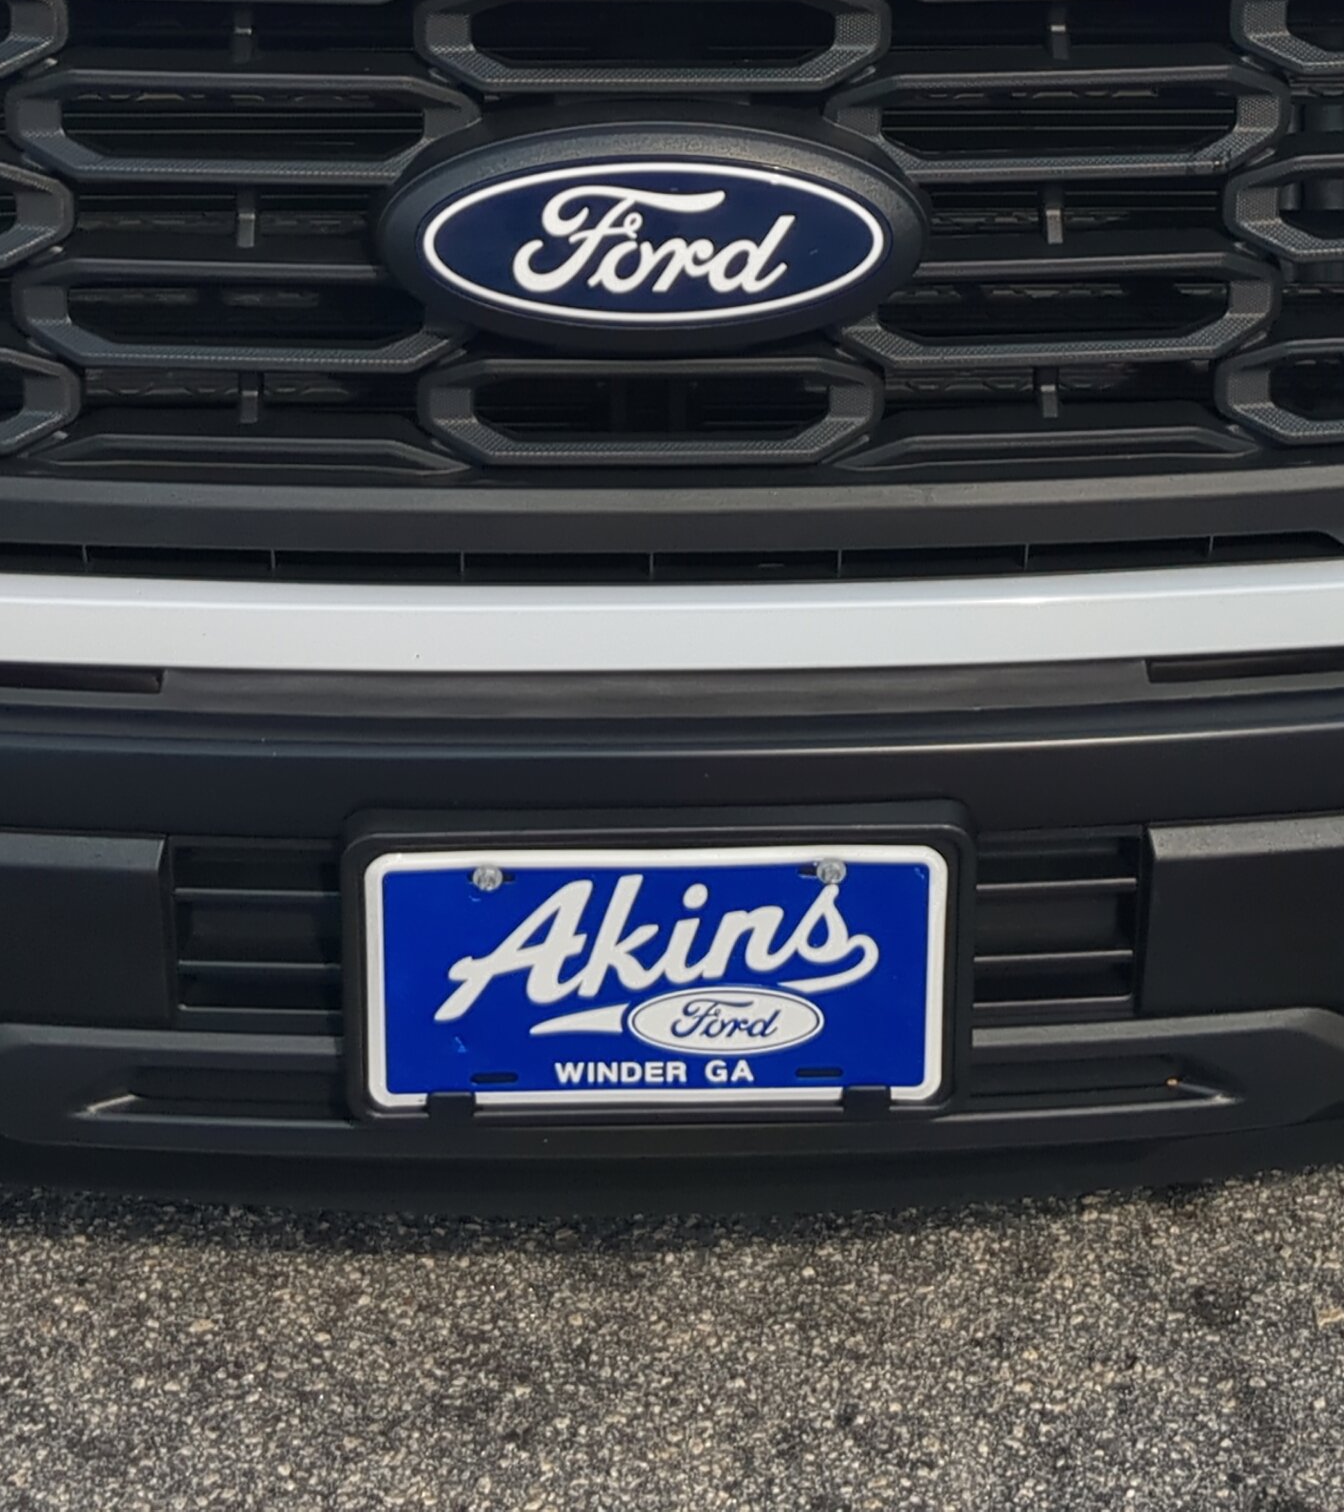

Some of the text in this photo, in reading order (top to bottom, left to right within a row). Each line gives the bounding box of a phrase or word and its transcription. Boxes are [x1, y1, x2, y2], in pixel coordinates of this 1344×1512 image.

[512, 185, 796, 294] Ford
[433, 873, 880, 1022] Akins
[670, 1000, 780, 1038] Ford
[554, 1059, 755, 1084] WINDER GA
